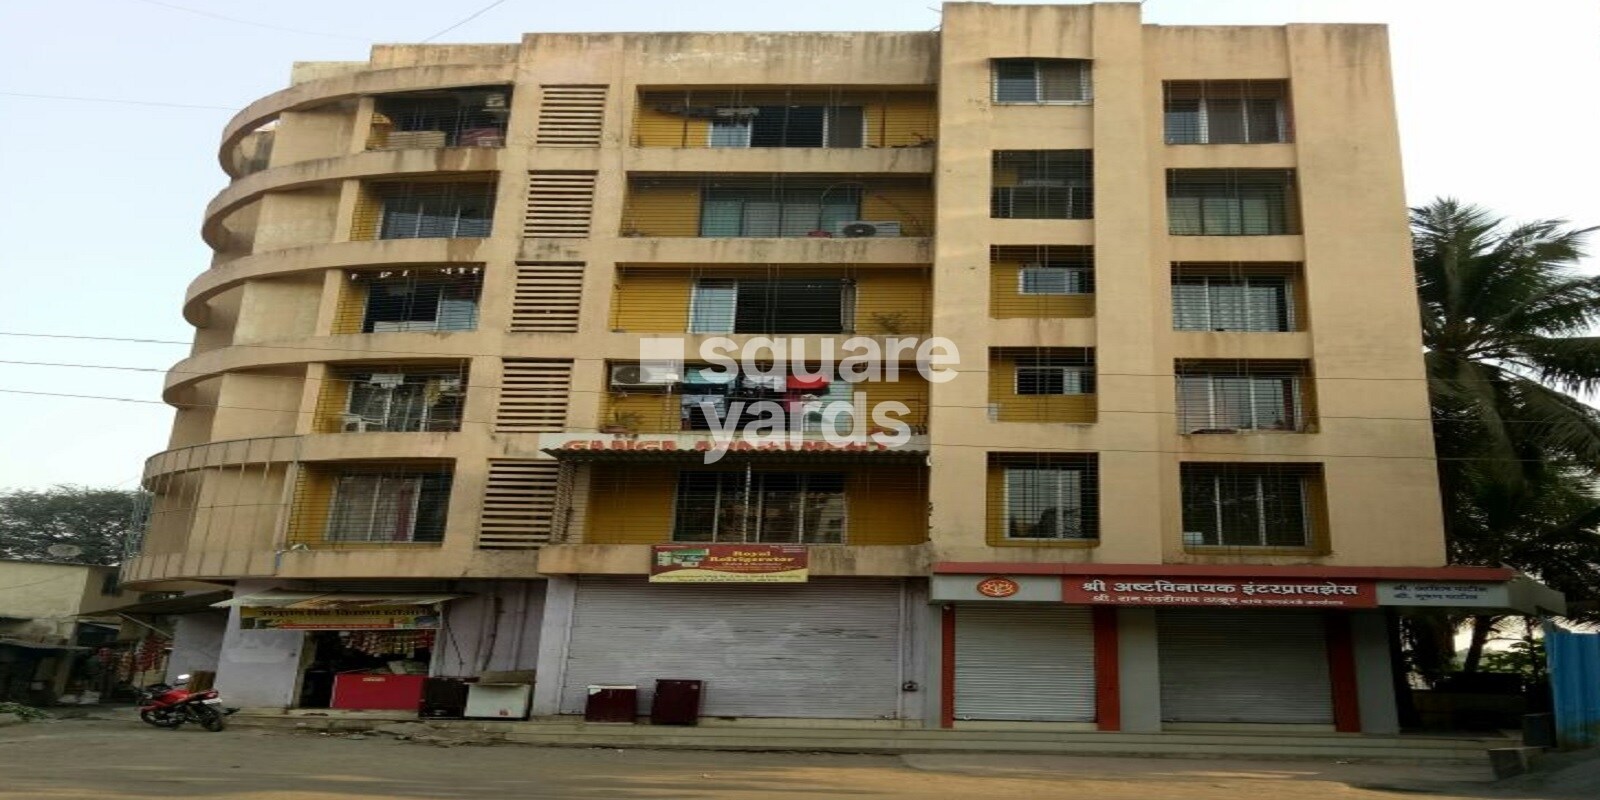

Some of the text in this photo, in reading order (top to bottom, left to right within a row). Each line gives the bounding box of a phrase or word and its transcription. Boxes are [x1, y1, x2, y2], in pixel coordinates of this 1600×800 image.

[1082, 580, 1358, 595] श्री अष्टविनायक इंटरप्रायझेस
